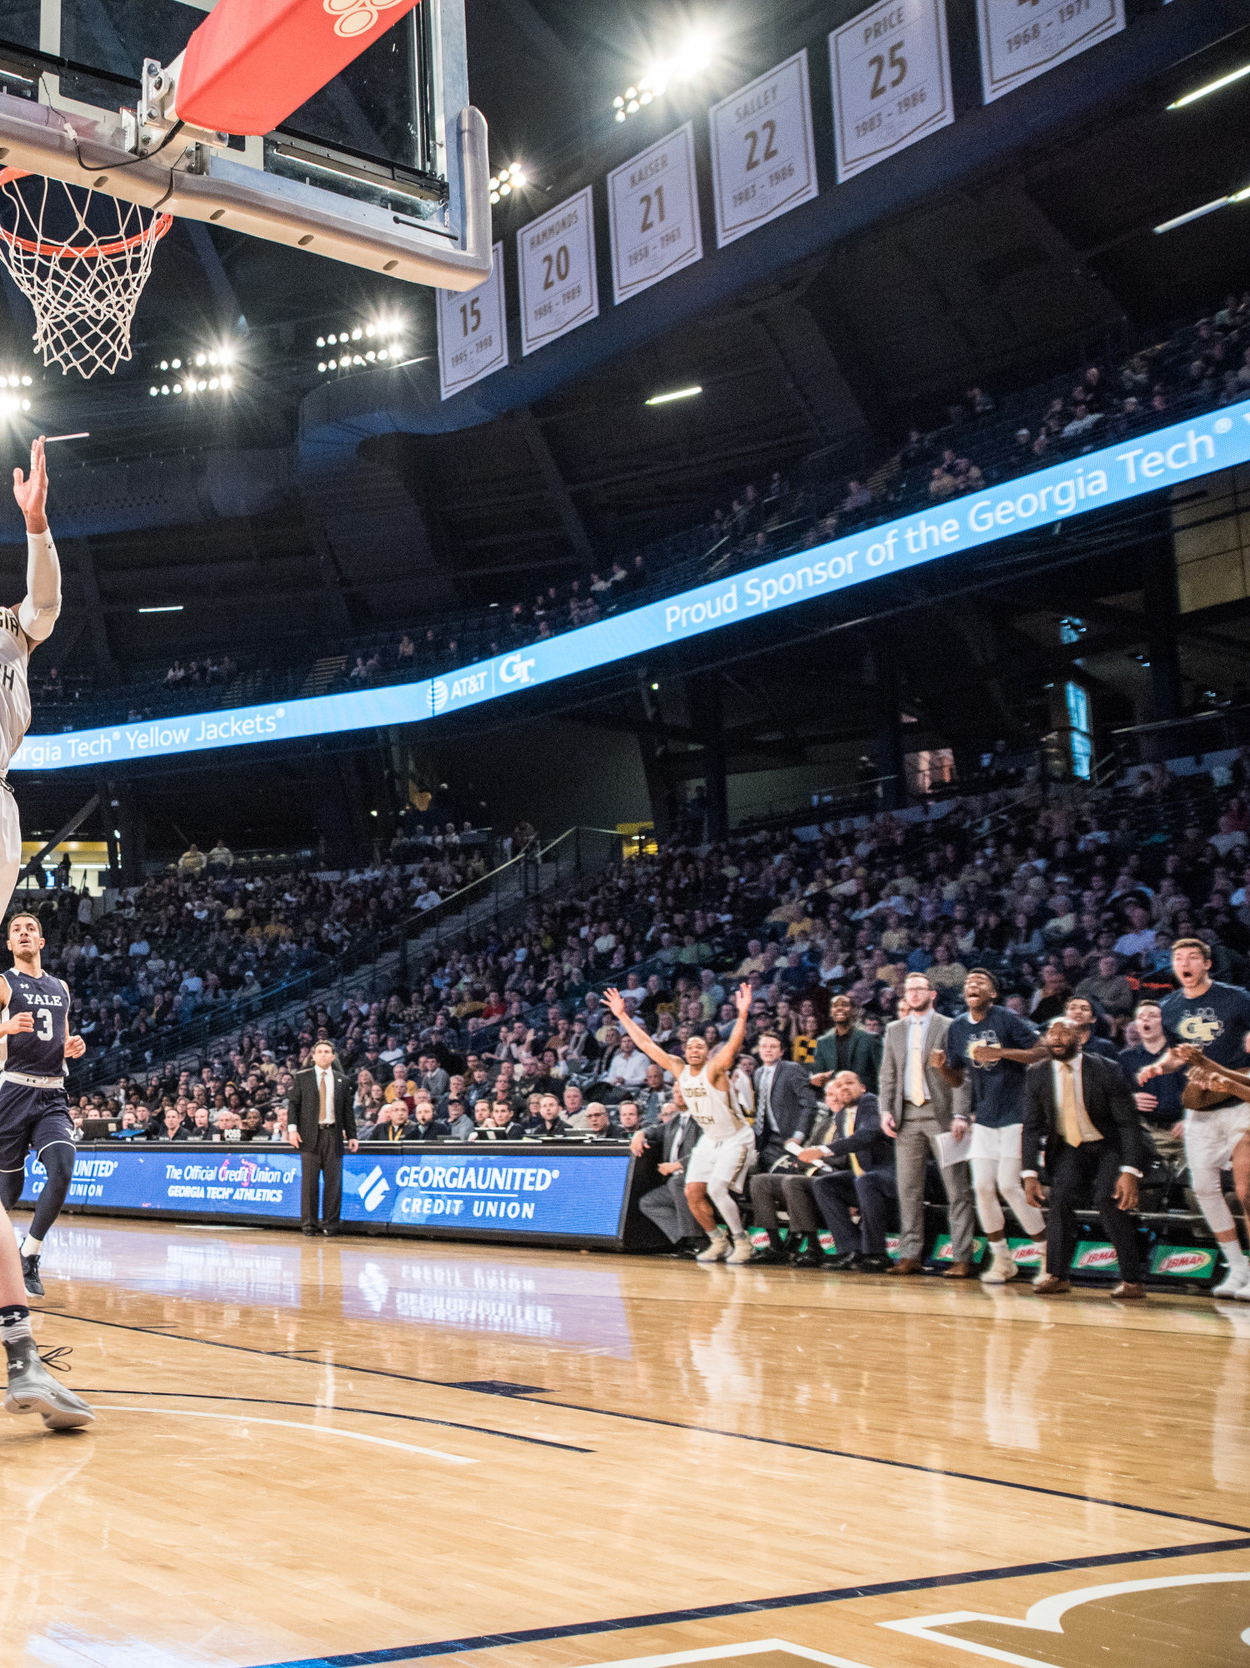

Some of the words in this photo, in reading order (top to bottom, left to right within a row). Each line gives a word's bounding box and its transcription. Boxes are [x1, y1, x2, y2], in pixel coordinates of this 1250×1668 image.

[863, 7, 906, 45] PRICE
[867, 40, 909, 100] 25
[743, 120, 778, 171] 22
[630, 154, 669, 188] KAISER
[639, 186, 666, 233] 21
[542, 245, 570, 291] 20
[460, 296, 481, 337] 15
[665, 580, 743, 633] Proud
[745, 551, 856, 609] Sponsor
[866, 529, 899, 567] of
[904, 517, 960, 555] the
[968, 469, 1108, 532] Georgia
[499, 654, 536, 684] GT
[450, 671, 487, 700] AT&T
[125, 725, 190, 751] Yellow
[23, 993, 63, 1006] YALE
[37, 1008, 53, 1041] 3
[166, 1165, 182, 1180] The
[184, 1165, 218, 1181] Official
[219, 1165, 250, 1182] Credit
[251, 1166, 281, 1184] Union
[283, 1168, 297, 1184] of
[69, 1184, 103, 1197] UNION
[167, 1185, 205, 1198] GEORGIA
[233, 1188, 283, 1203] ATHLETICS
[402, 1198, 463, 1215] CREDIT
[473, 1201, 535, 1219] UNION
[1080, 1250, 1117, 1267] LIBMA
